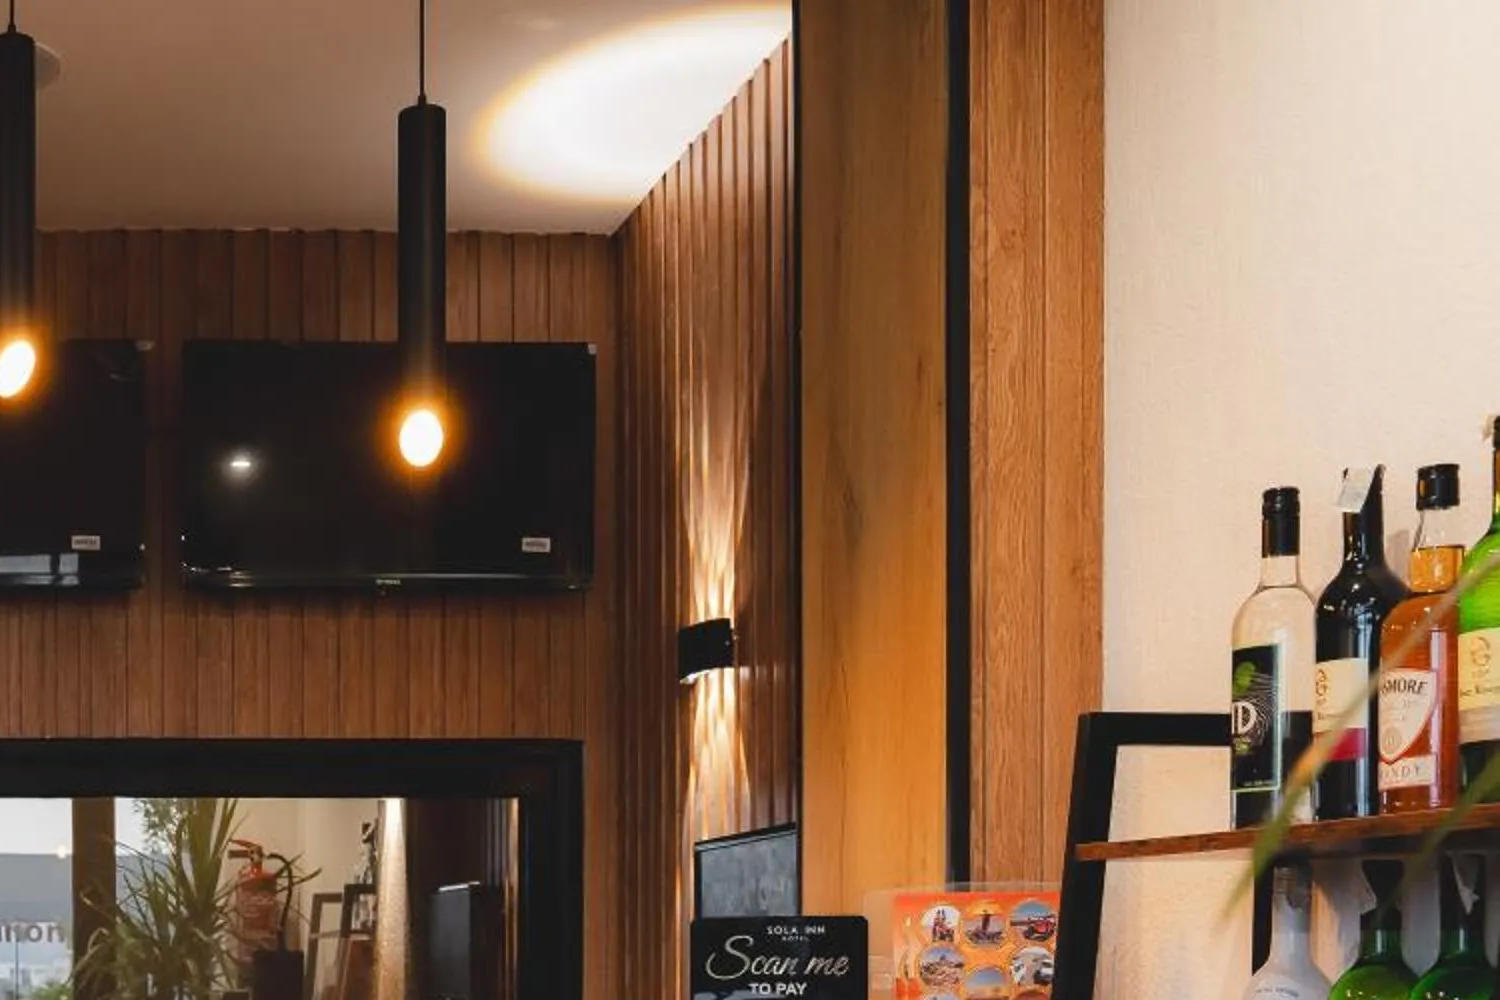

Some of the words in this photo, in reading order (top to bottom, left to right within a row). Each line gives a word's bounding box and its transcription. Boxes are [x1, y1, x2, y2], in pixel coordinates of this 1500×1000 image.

[766, 925, 799, 935] SOLA
[705, 934, 800, 980] Scan
[803, 955, 850, 977] me
[748, 982, 771, 995] TO
[775, 982, 808, 996] PAY
